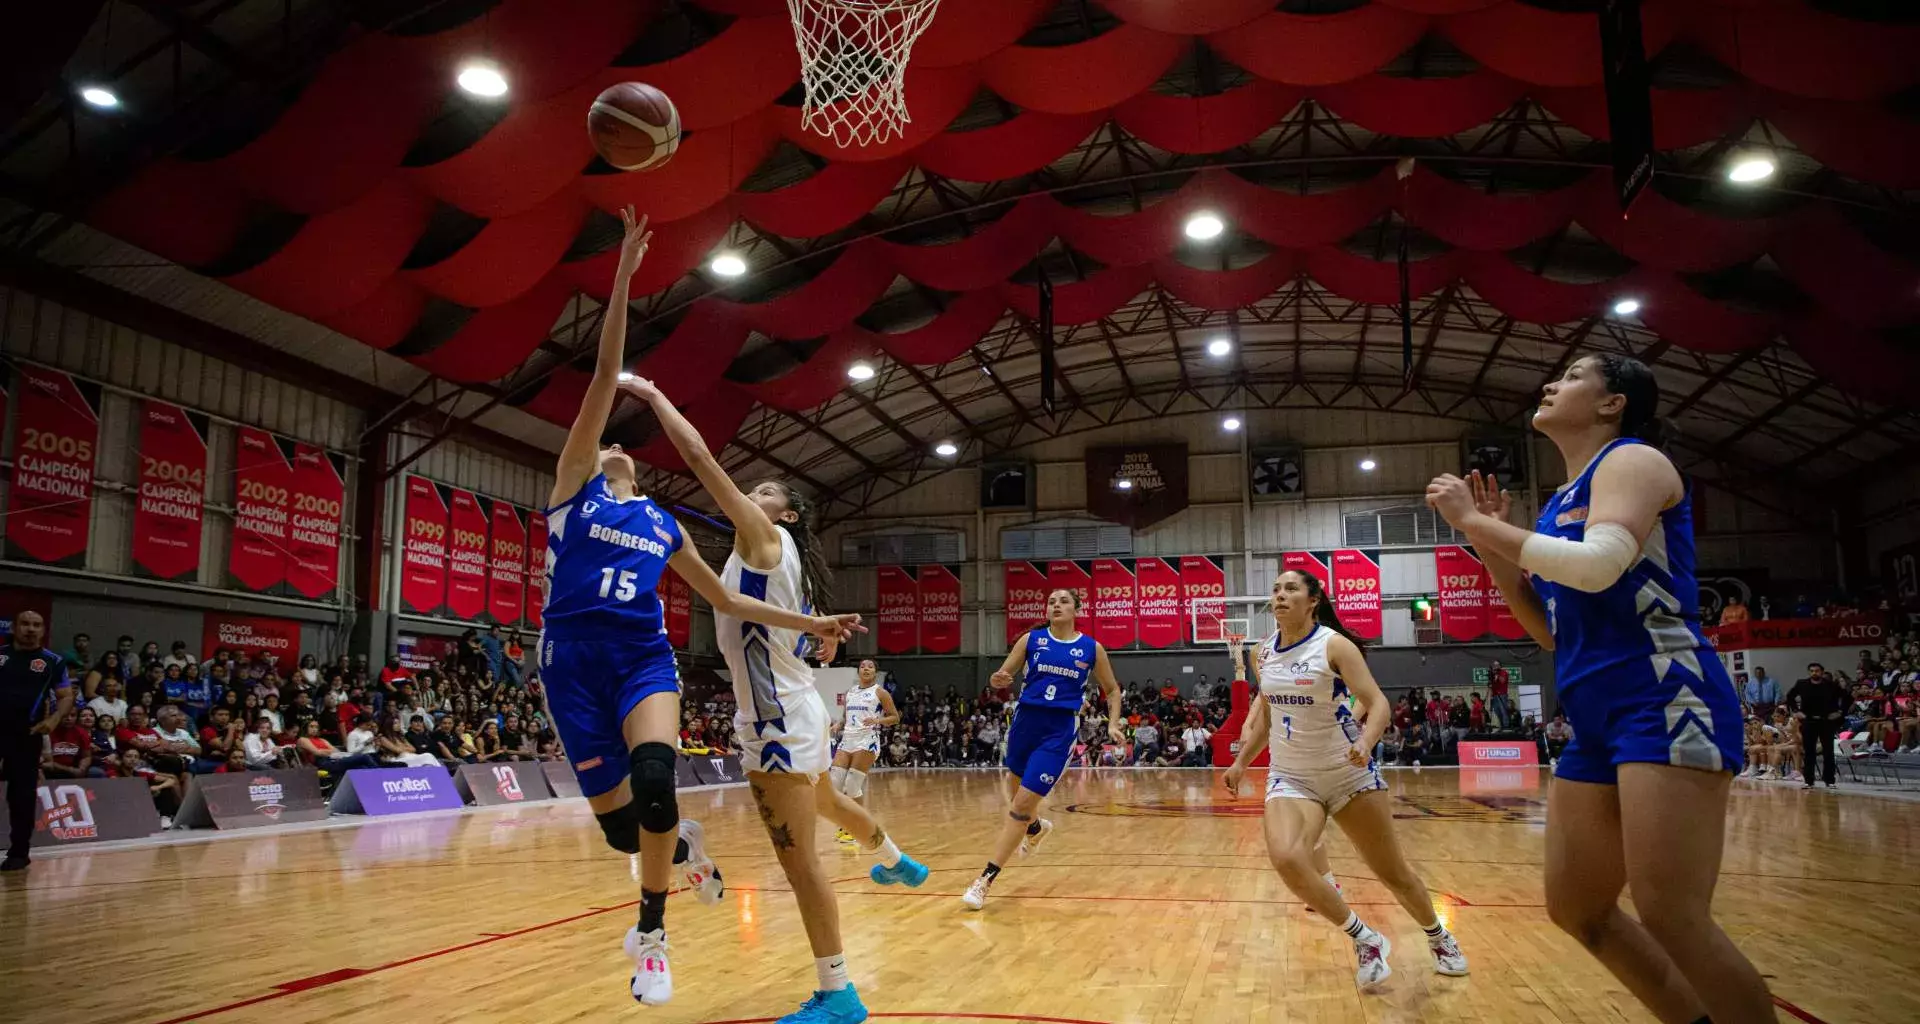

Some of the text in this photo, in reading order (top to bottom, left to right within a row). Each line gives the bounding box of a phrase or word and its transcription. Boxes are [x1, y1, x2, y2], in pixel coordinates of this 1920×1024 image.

[29, 376, 60, 391] SOMOS
[22, 427, 92, 462] 2005
[1124, 453, 1150, 463] 2012
[18, 454, 90, 482] CAMPEÓN
[144, 457, 202, 486] 2004
[1121, 462, 1153, 471] DOBLE
[17, 473, 87, 499] NACIONAL
[141, 482, 202, 506] CAMPEÓN
[239, 478, 288, 506] 2002
[141, 499, 199, 521] NACIONAL
[236, 501, 288, 524] CAMPEÓN
[293, 492, 340, 517] 2000
[235, 516, 286, 538] NACIONAL
[292, 514, 339, 534] CAMPEÓN
[409, 517, 445, 541] 1999
[291, 528, 337, 547] NACIONAL
[453, 528, 485, 551] 1999
[588, 523, 665, 559] BORREGOS
[407, 538, 445, 555] CAMPEÓN
[494, 539, 523, 559] 1999
[407, 552, 444, 568] NACIONAL
[451, 548, 486, 566] CAMPEÓN
[492, 557, 523, 573] CAMPEÓN
[451, 562, 484, 577] NACIONAL
[492, 569, 522, 584] NACIONAL
[598, 567, 638, 602] 15
[1338, 577, 1377, 591] 1989
[1441, 574, 1479, 588] 1987
[1009, 589, 1044, 602] 1996
[1096, 587, 1132, 600] 1993
[1140, 584, 1177, 598] 1992
[1184, 583, 1223, 597] 1990
[1338, 591, 1379, 602] CAMPEÓN
[1441, 588, 1482, 598] CAMPEÓN
[881, 592, 914, 605] 1996
[922, 592, 958, 605] 1996
[1008, 602, 1045, 611] CAMPEÓN
[1095, 599, 1133, 609] CAMPEÓN
[1139, 598, 1177, 608] CAMPEÓN
[1338, 601, 1379, 610] NACIONAL
[1441, 599, 1483, 607] NACIONAL
[1009, 611, 1045, 619] NACIONAL
[1095, 608, 1133, 617] NACIONAL
[1140, 608, 1178, 616] NACIONAL
[219, 623, 252, 635] SOMOS
[1838, 624, 1882, 640] ALTO
[1037, 663, 1080, 679] BORREGOS
[1044, 684, 1057, 700] 9
[382, 777, 432, 793] molten
[36, 784, 95, 829] 10
